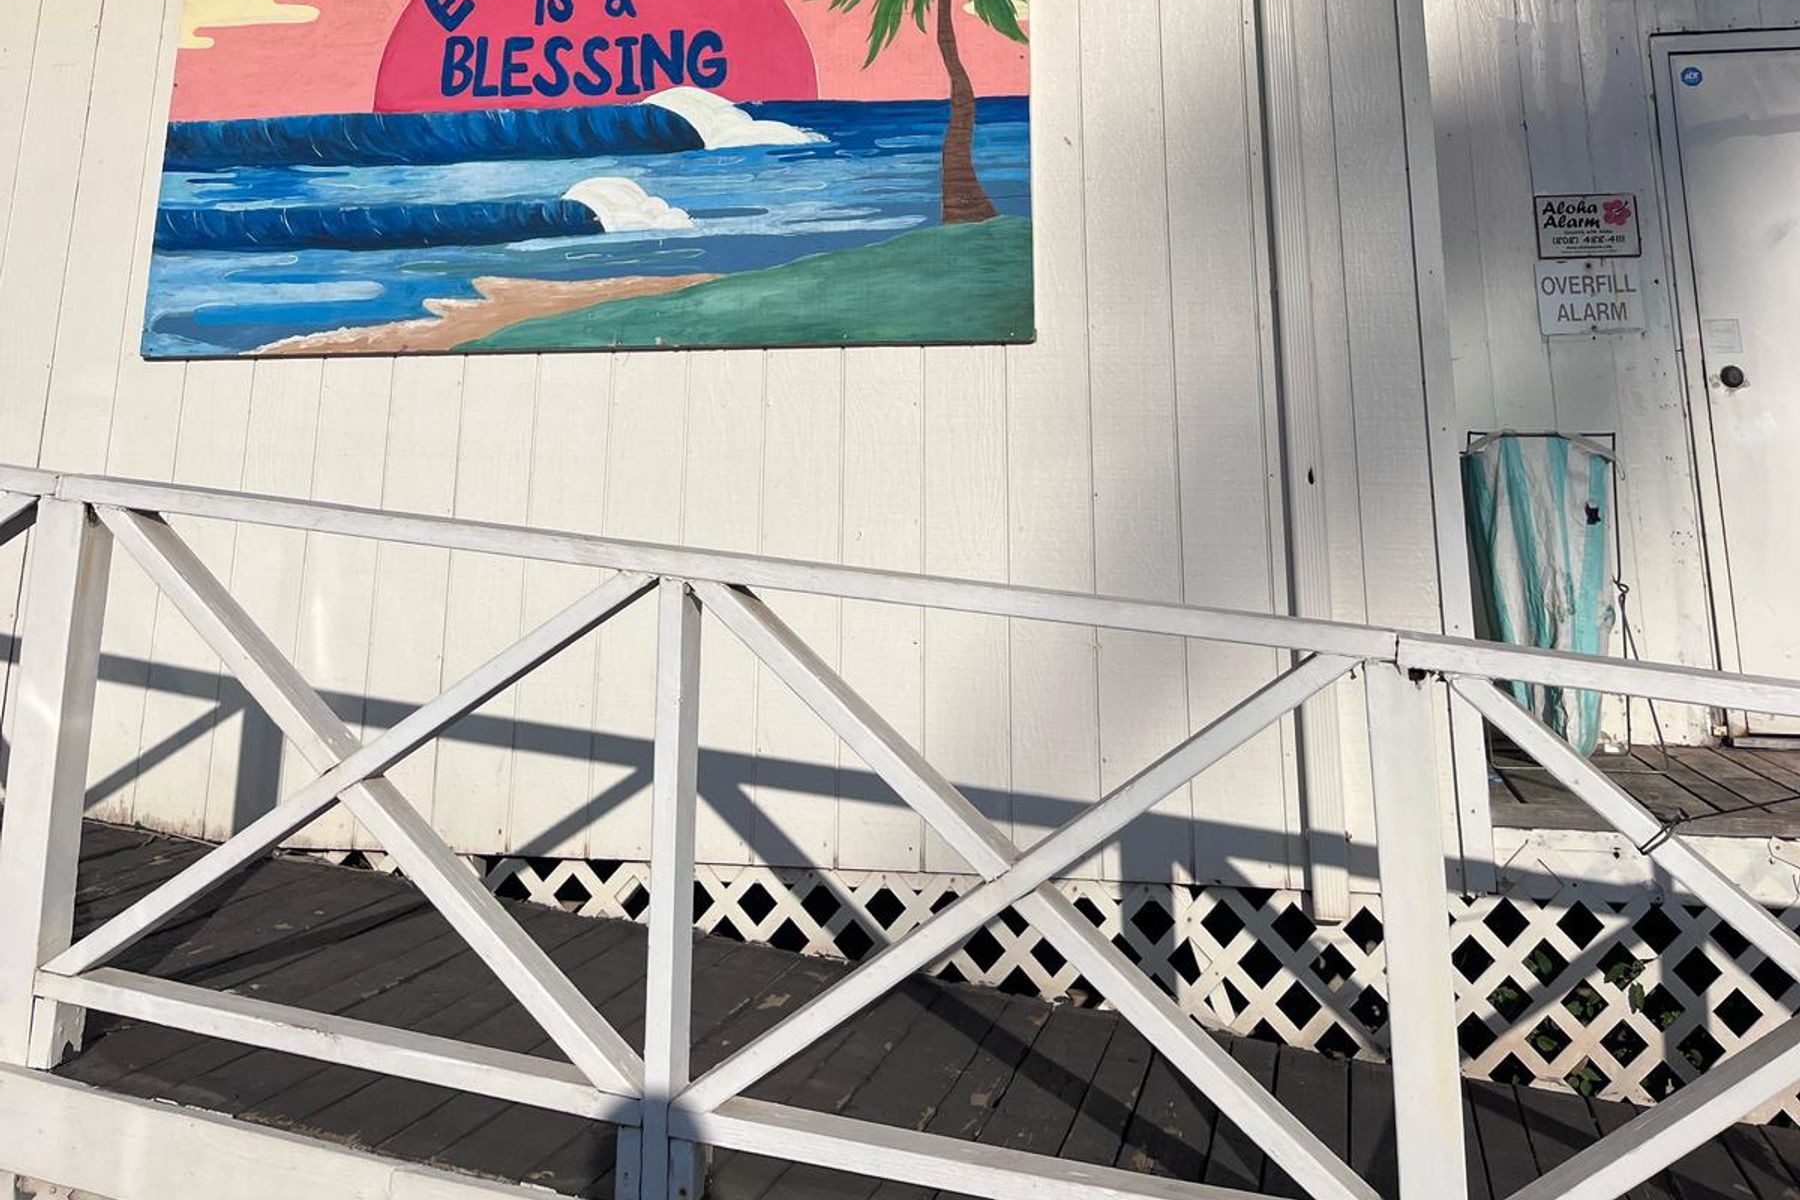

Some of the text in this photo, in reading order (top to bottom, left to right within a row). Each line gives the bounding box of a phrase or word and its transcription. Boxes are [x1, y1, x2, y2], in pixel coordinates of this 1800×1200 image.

[440, 29, 728, 98] BLESSING
[1542, 200, 1598, 215] Aloha
[1543, 214, 1600, 229] Alarm
[1541, 274, 1637, 295] OVERFILL
[1557, 301, 1628, 322] ALARM
